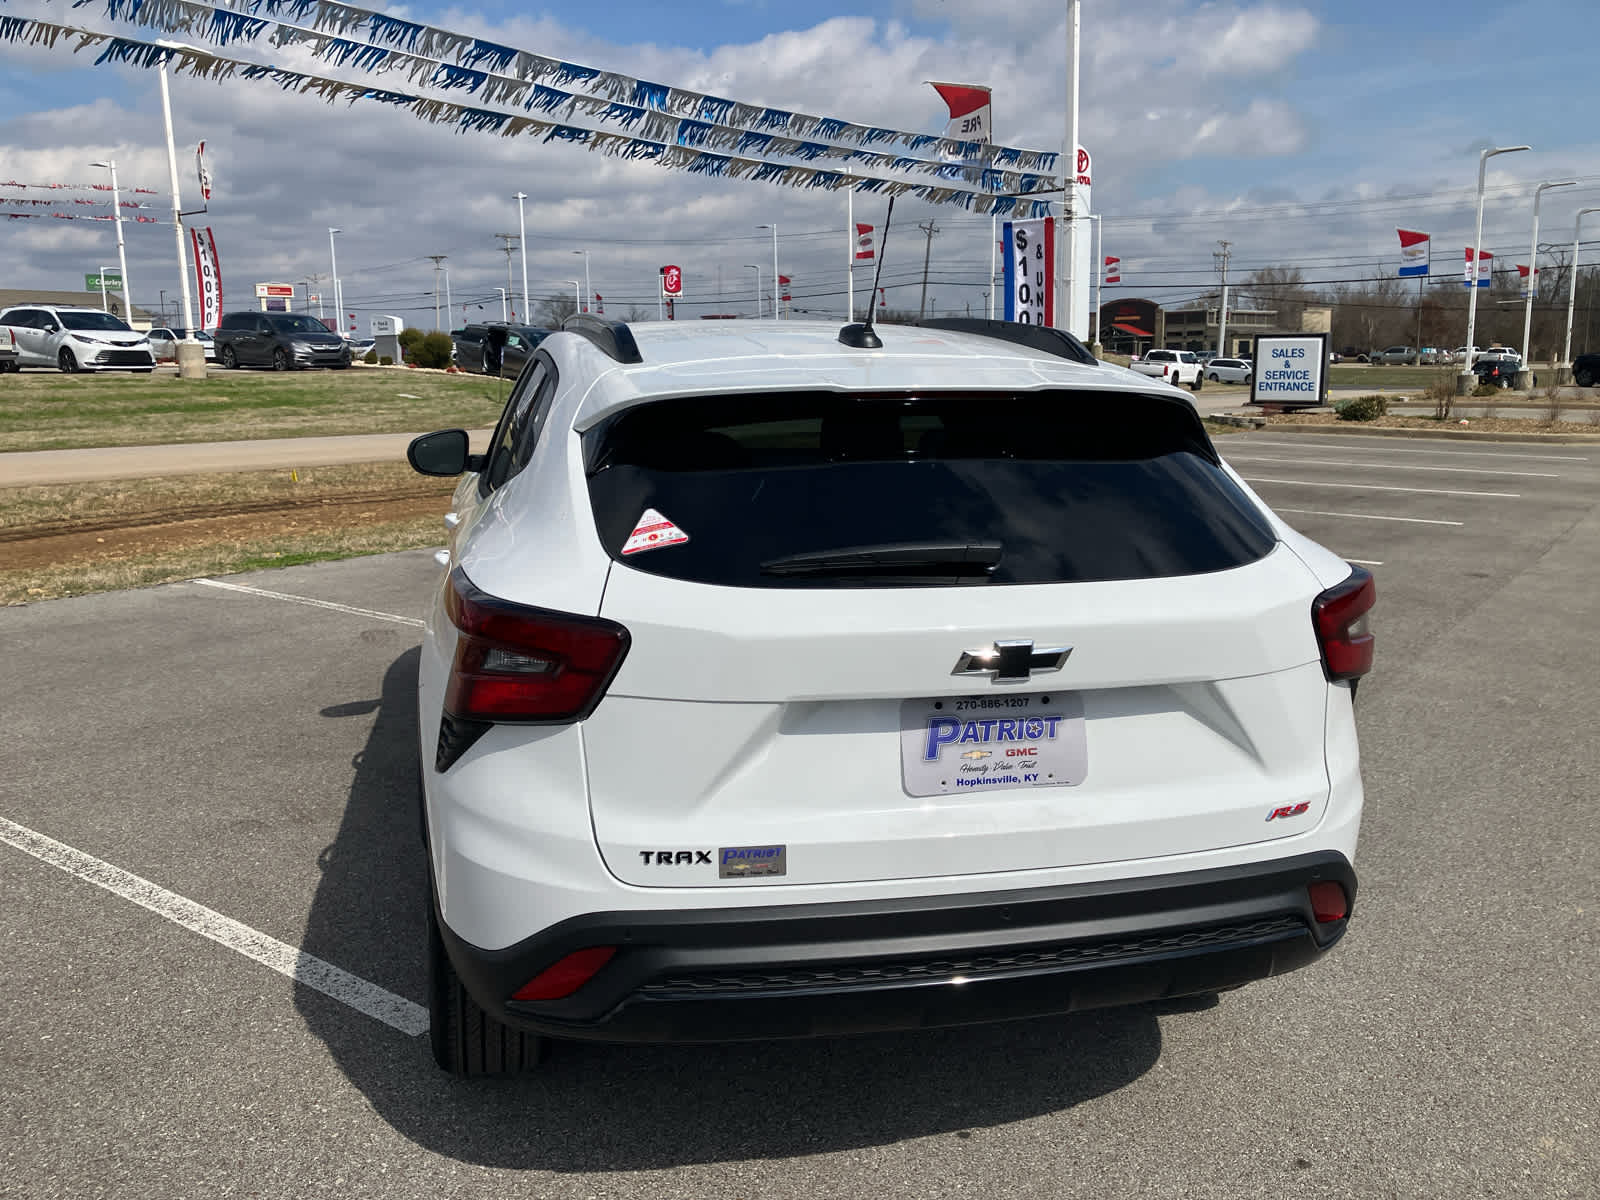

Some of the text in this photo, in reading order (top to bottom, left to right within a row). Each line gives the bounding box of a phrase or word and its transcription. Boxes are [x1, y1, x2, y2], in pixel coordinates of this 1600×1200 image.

[1036, 244, 1043, 259] &
[1271, 348, 1305, 358] SALES
[1284, 359, 1291, 369] &
[1264, 370, 1310, 380] SERVICE
[1258, 381, 1315, 392] ENTRANCE
[956, 698, 1030, 711] 270-886-1207
[924, 716, 1062, 760] PATRIOT
[1005, 747, 1038, 757] GMC
[956, 773, 1039, 787] Hopkinsville, KY
[639, 850, 713, 865] TRAX
[722, 847, 782, 865] PATRIOT
